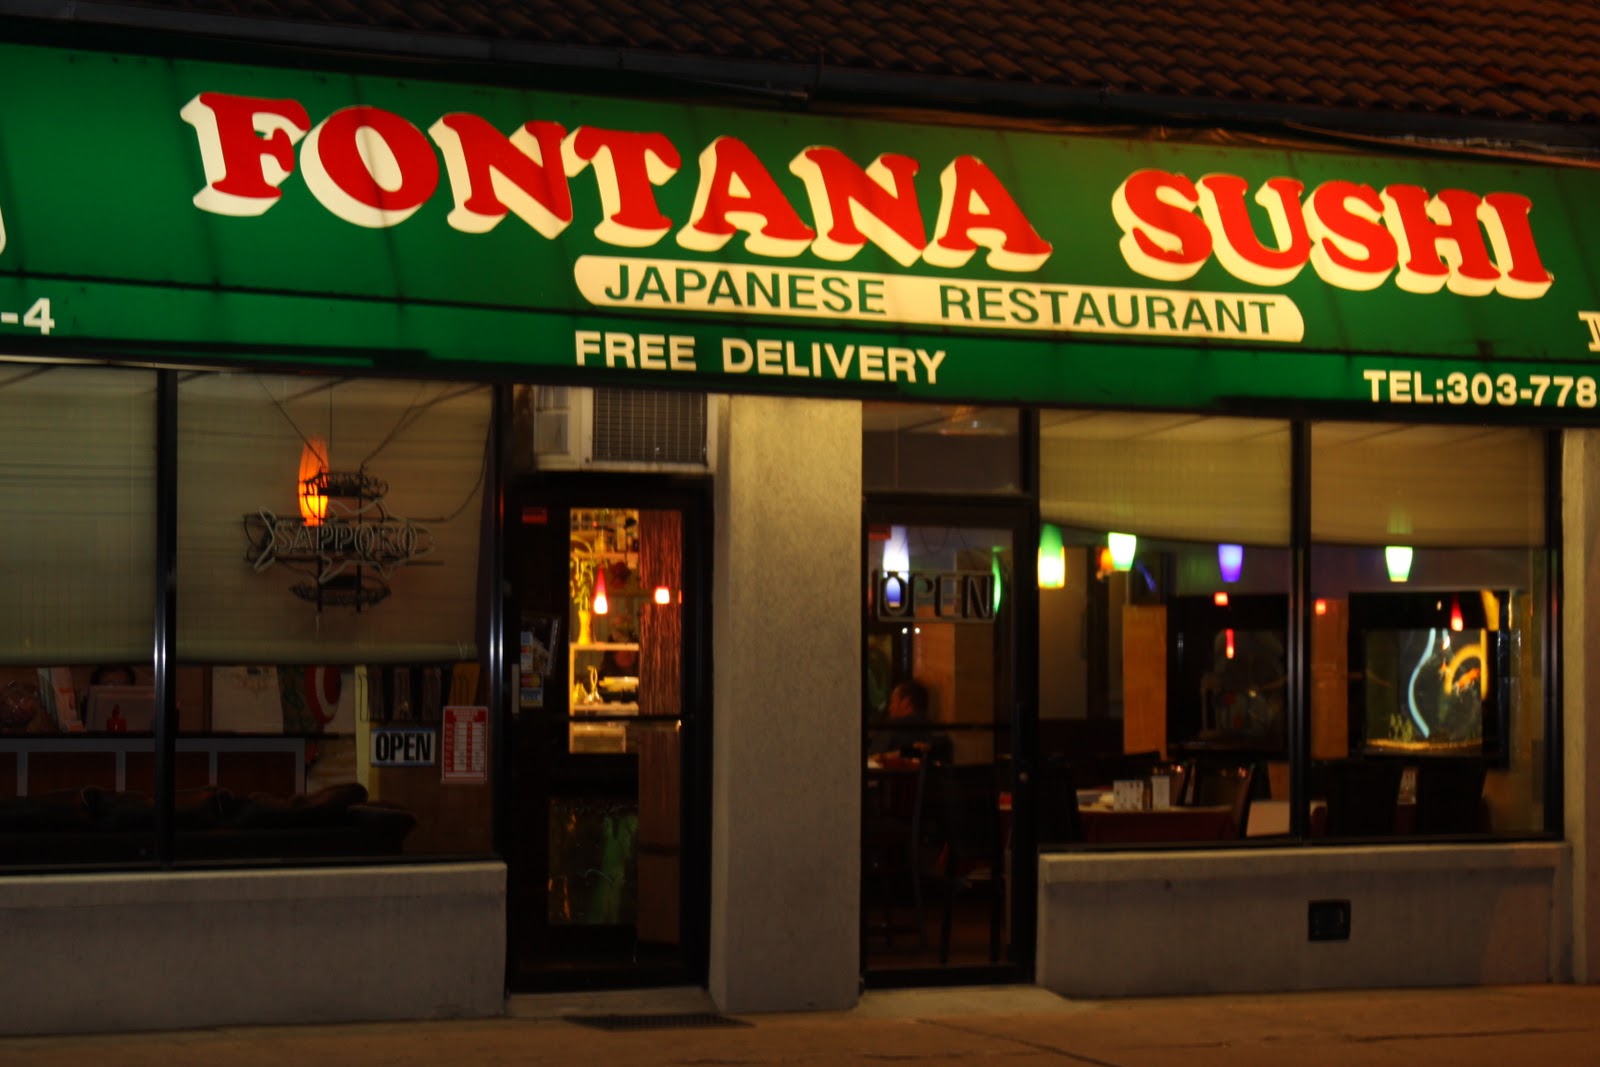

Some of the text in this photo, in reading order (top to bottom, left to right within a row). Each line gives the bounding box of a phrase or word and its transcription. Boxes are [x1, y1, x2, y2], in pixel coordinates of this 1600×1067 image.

[181, 92, 1555, 300] FONTANA SUSHI
[605, 260, 1277, 336] JAPANESE RESTAURANT
[575, 330, 947, 385] FREE DELIVERY
[274, 522, 418, 559] SAPPORO
[880, 573, 992, 620] OPEN
[375, 732, 432, 762] OPEN
